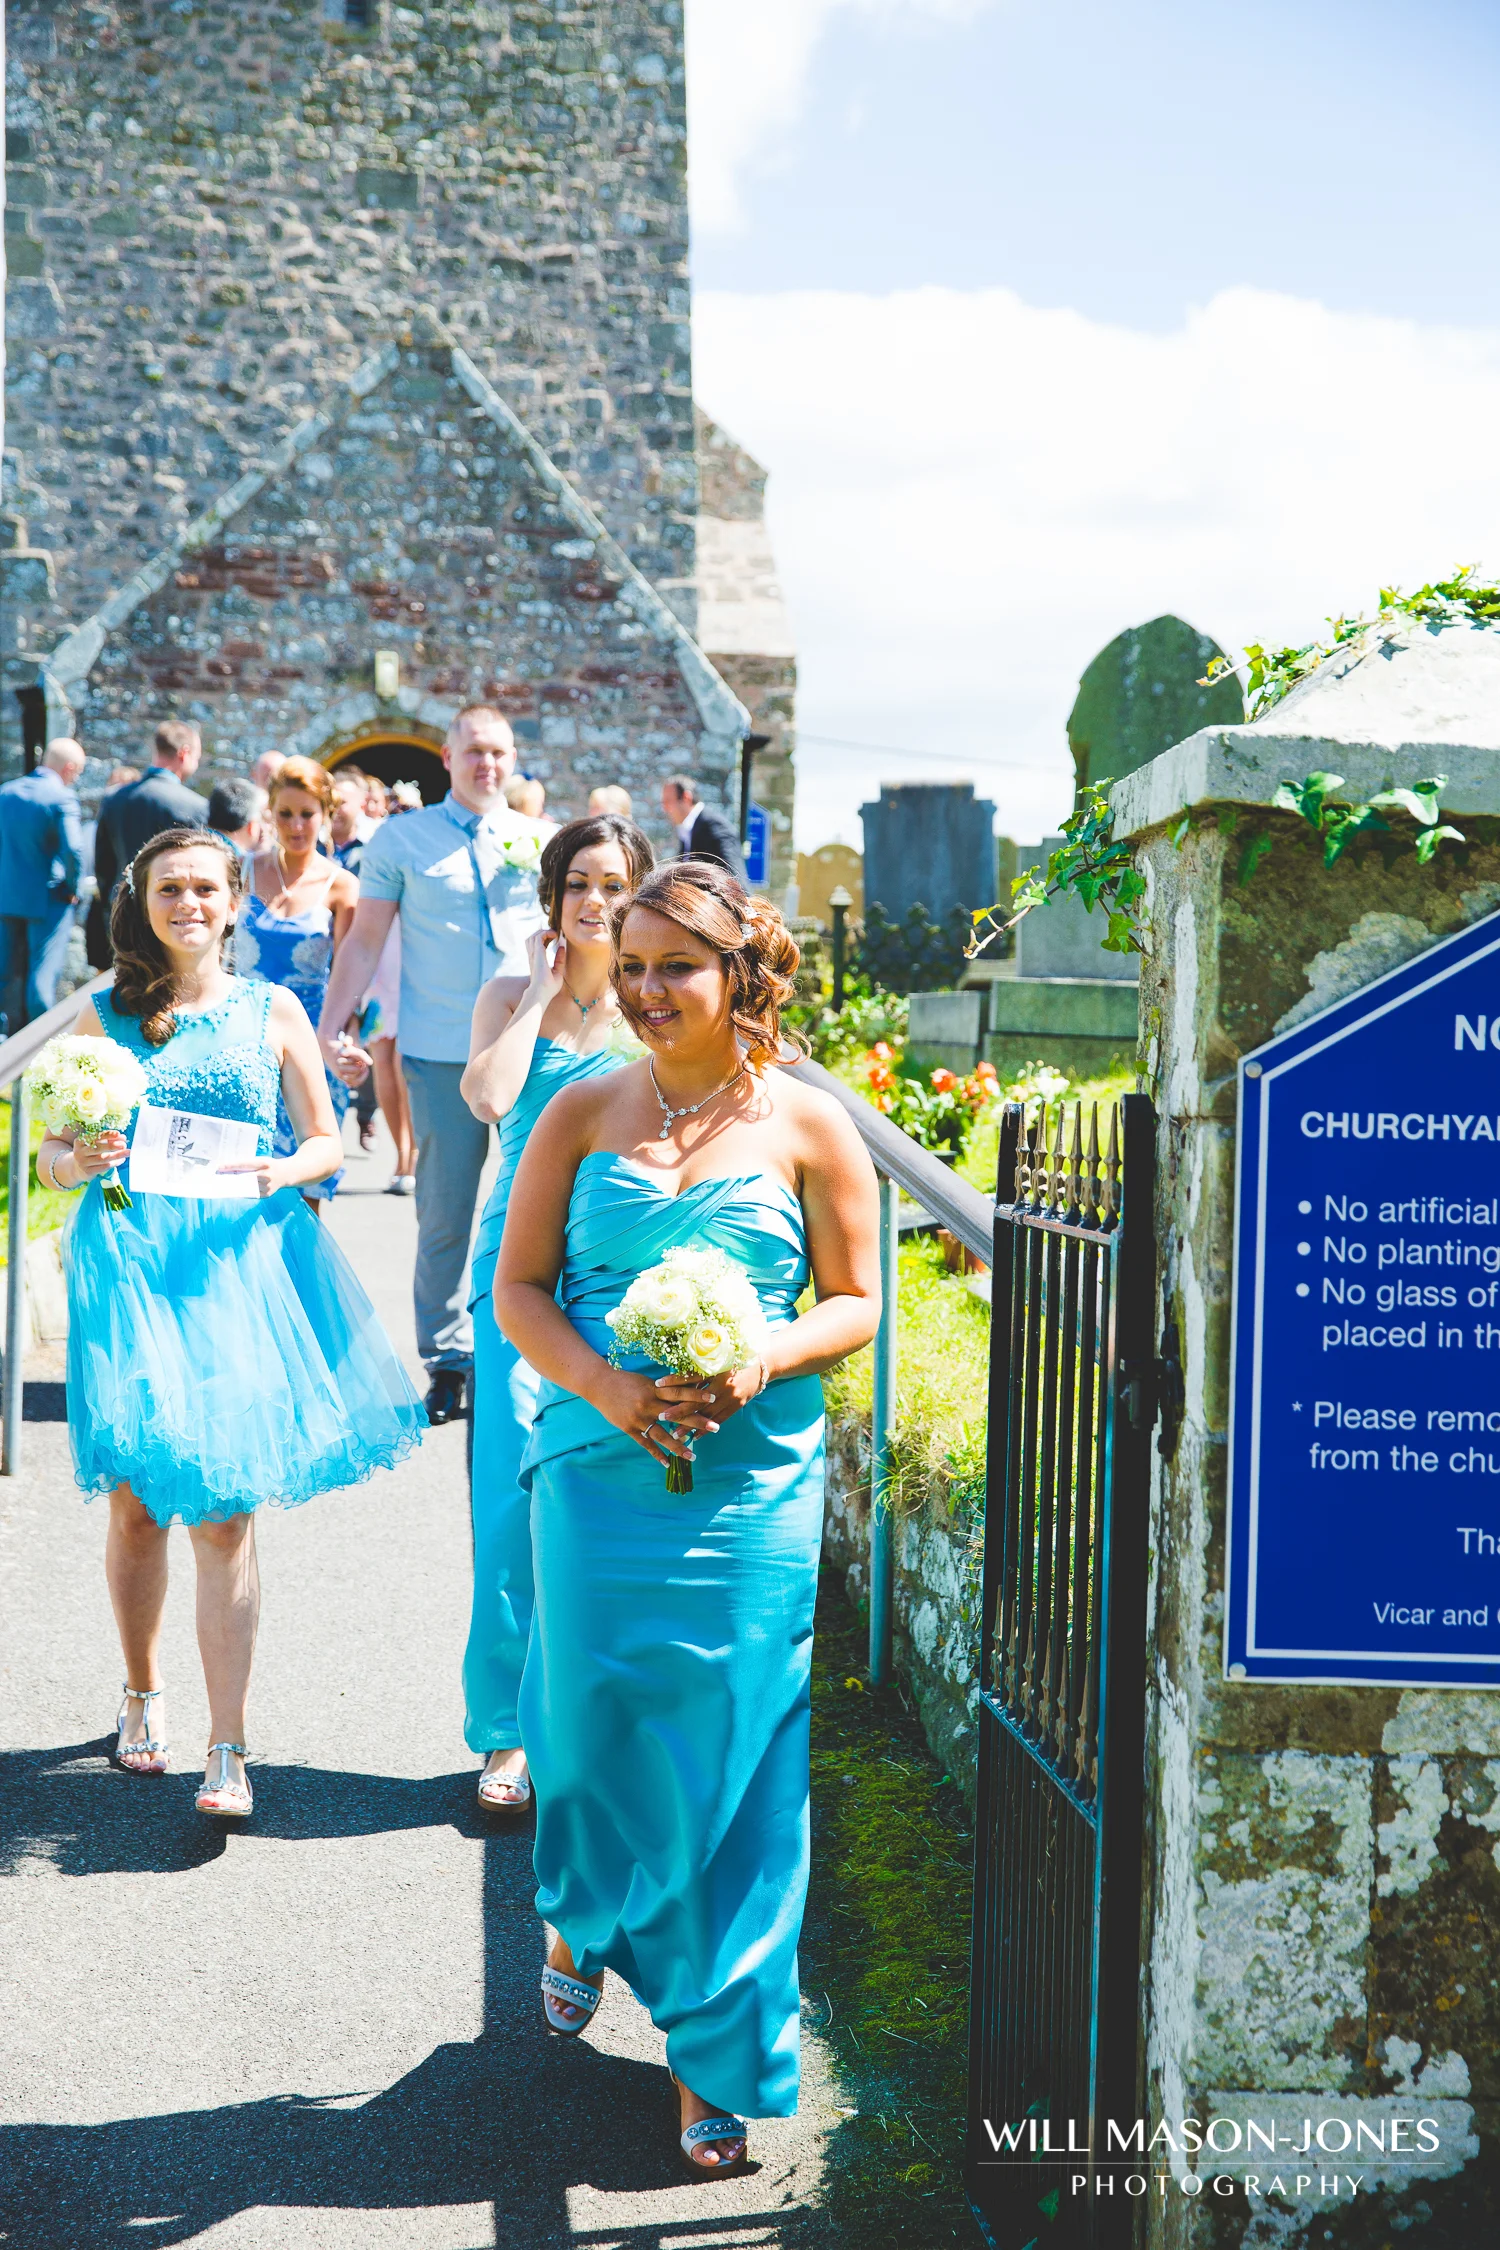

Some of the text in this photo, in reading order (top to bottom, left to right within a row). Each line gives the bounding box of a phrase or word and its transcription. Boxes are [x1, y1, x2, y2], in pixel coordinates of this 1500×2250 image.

[1300, 1110, 1500, 1142] CHURCHYA
[1324, 1194, 1498, 1225] No artificial
[1322, 1235, 1500, 1274] No planting
[1322, 1277, 1499, 1313] No glass of
[1322, 1319, 1427, 1352] placed
[1438, 1321, 1463, 1349] in
[1314, 1401, 1417, 1431] Please
[1309, 1442, 1379, 1471] from
[1389, 1444, 1439, 1473] the
[1456, 1527, 1500, 1555] Th
[1373, 1602, 1435, 1626] Vicar
[1442, 1605, 1488, 1627] and
